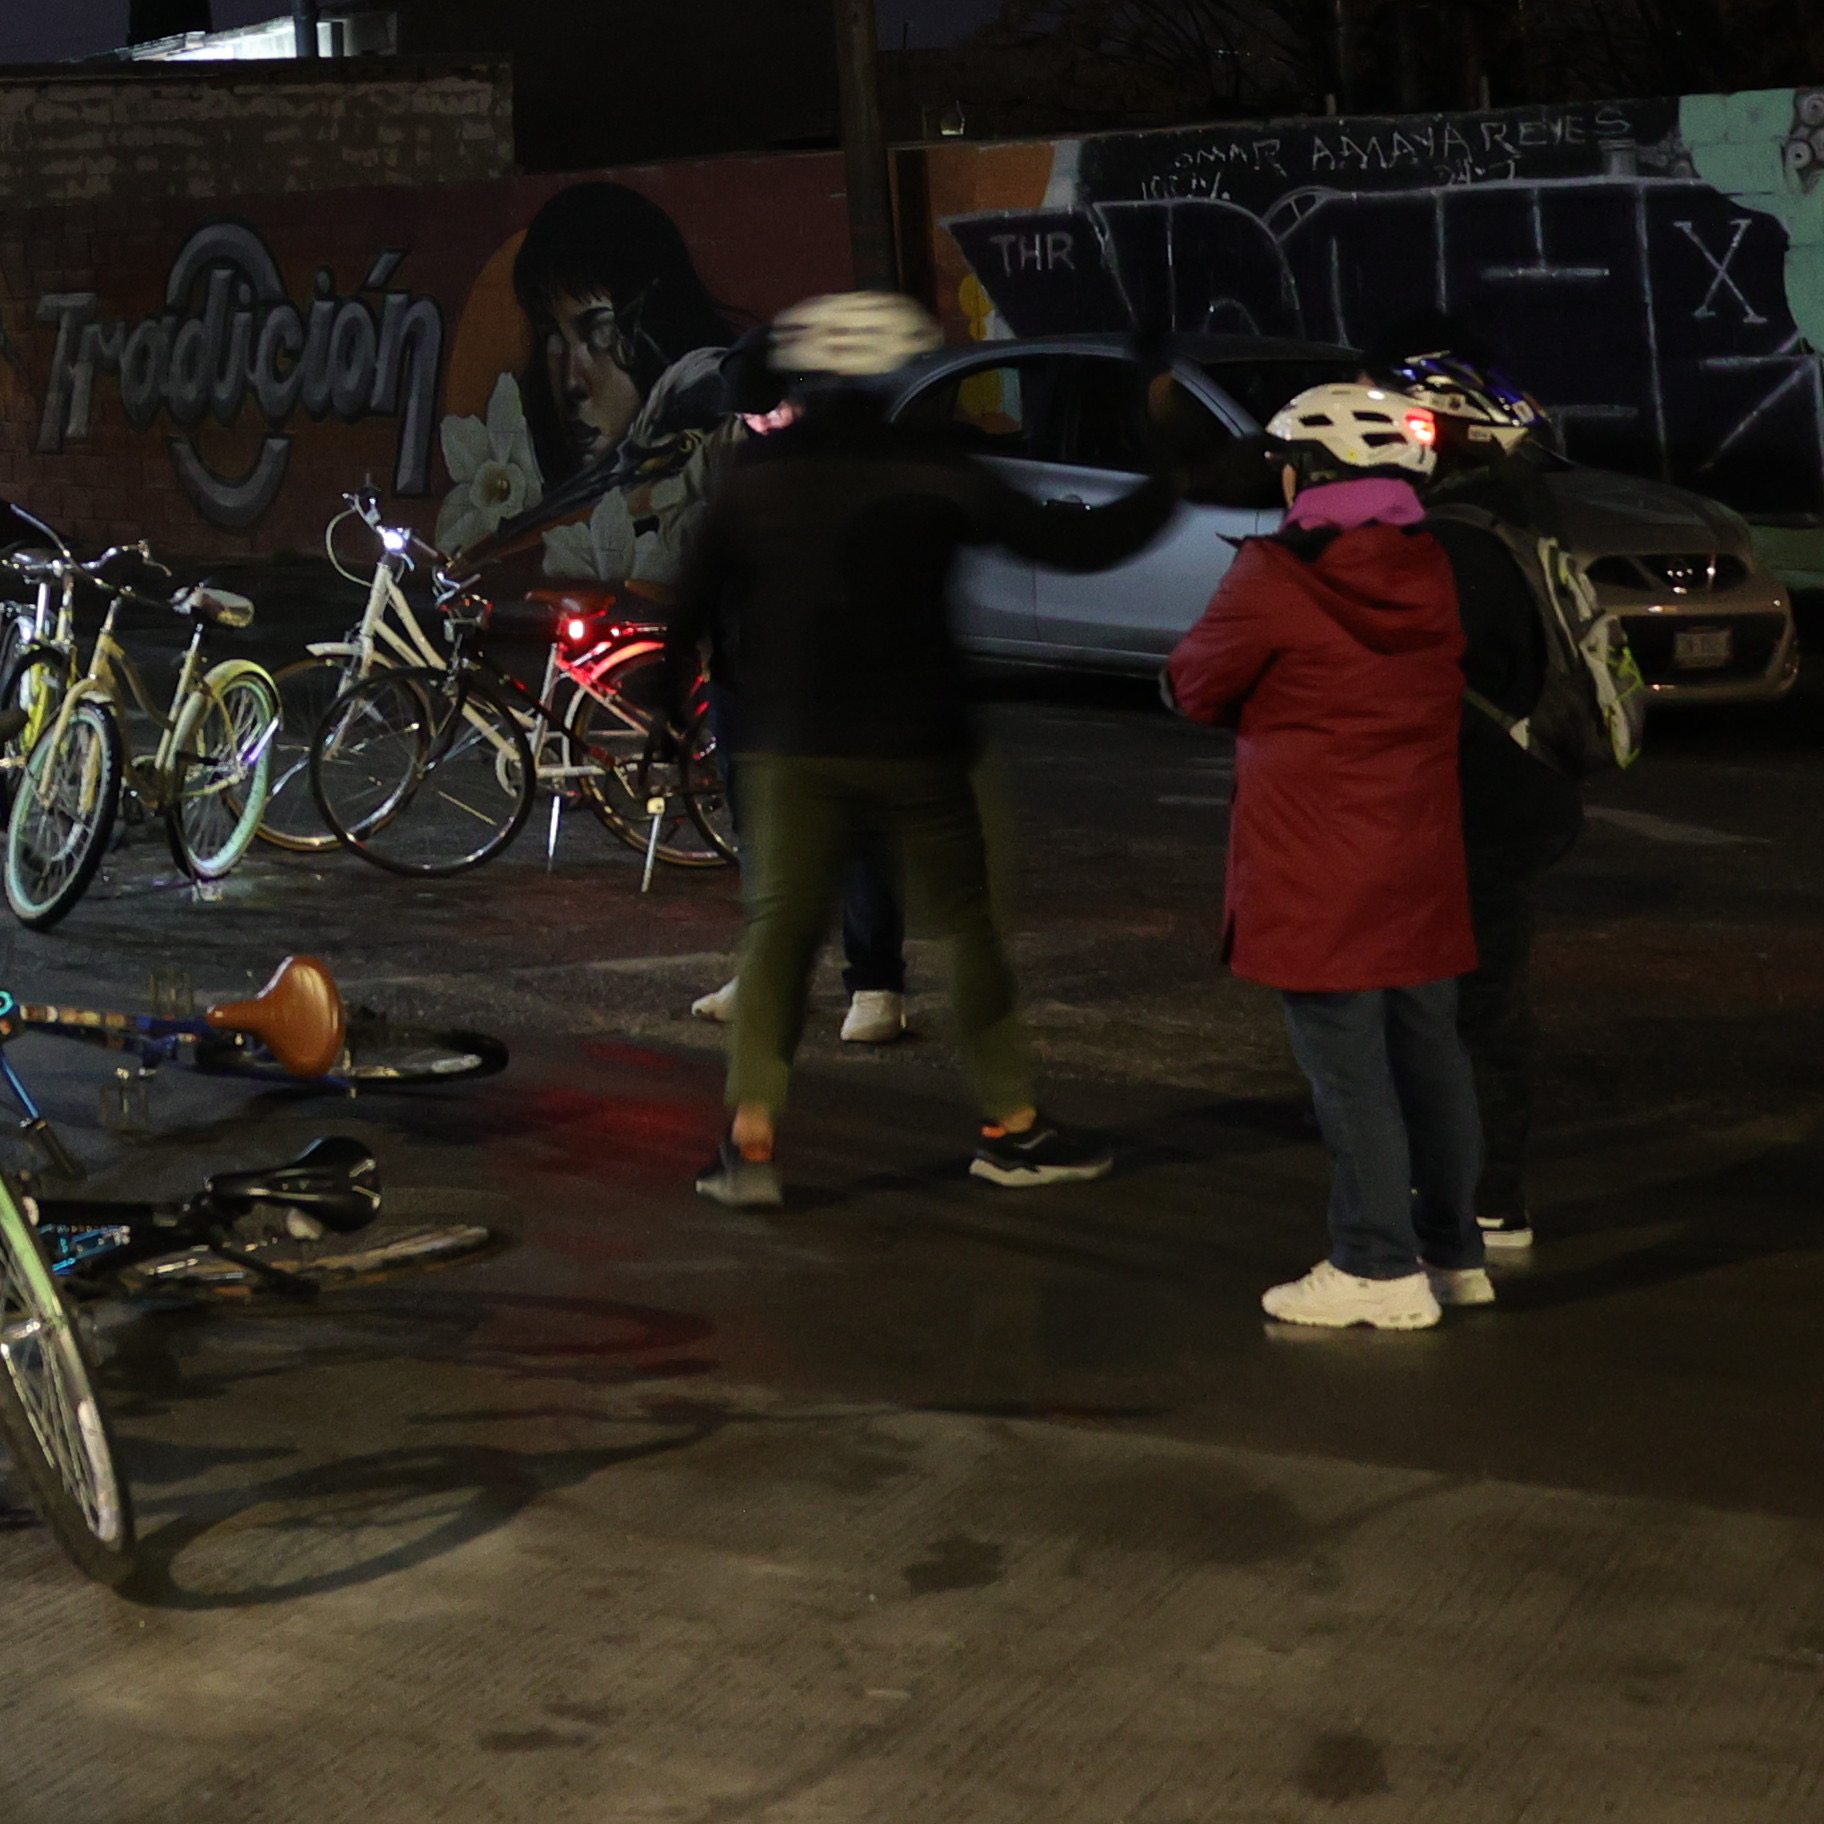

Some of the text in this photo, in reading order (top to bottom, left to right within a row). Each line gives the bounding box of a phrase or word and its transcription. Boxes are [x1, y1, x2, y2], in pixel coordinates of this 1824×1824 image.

[1480, 106, 1631, 159] REYES
[988, 231, 1077, 275] THR
[35, 246, 443, 499] Tradición
